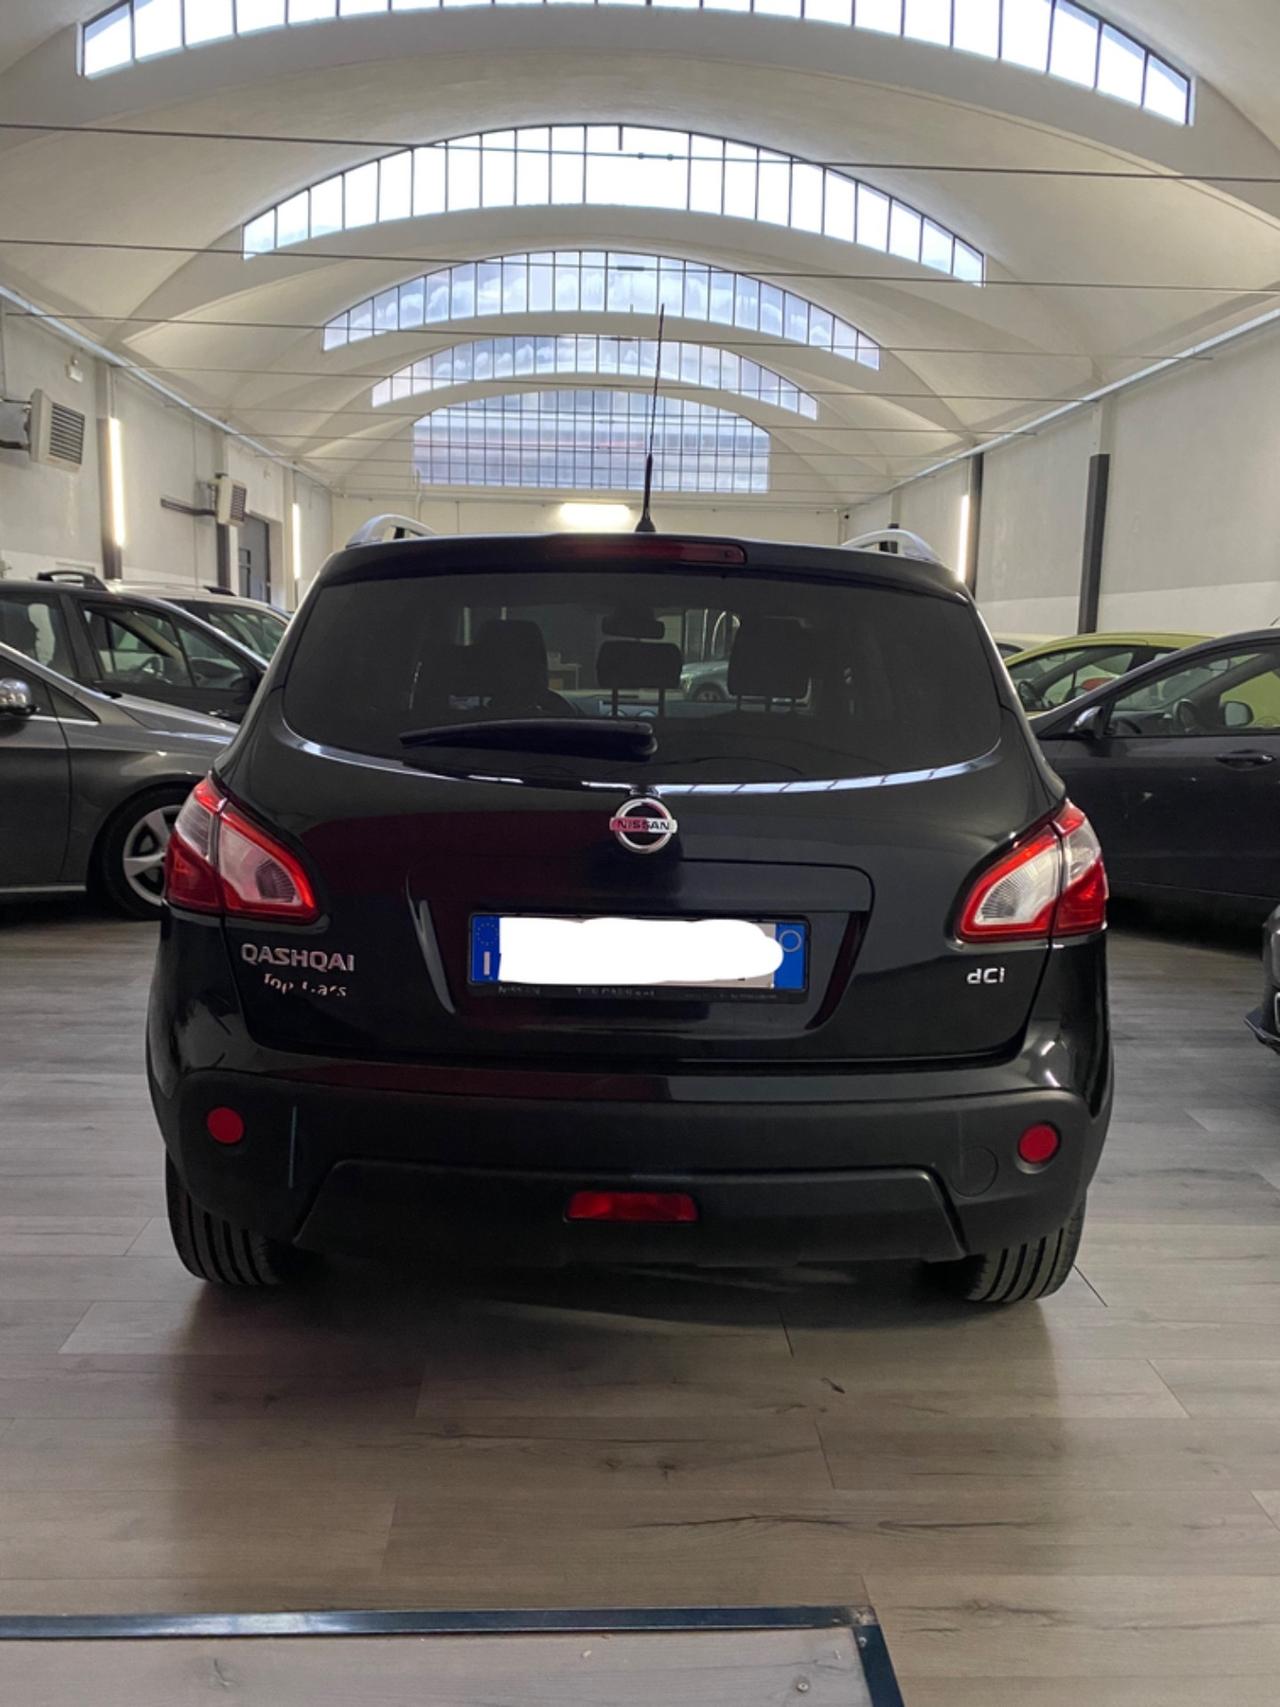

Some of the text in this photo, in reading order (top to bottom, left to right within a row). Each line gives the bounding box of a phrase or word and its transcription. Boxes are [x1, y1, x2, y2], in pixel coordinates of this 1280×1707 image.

[617, 820, 670, 831] NISSAN
[240, 943, 355, 972] QASHQAI
[966, 966, 1006, 985] dCi
